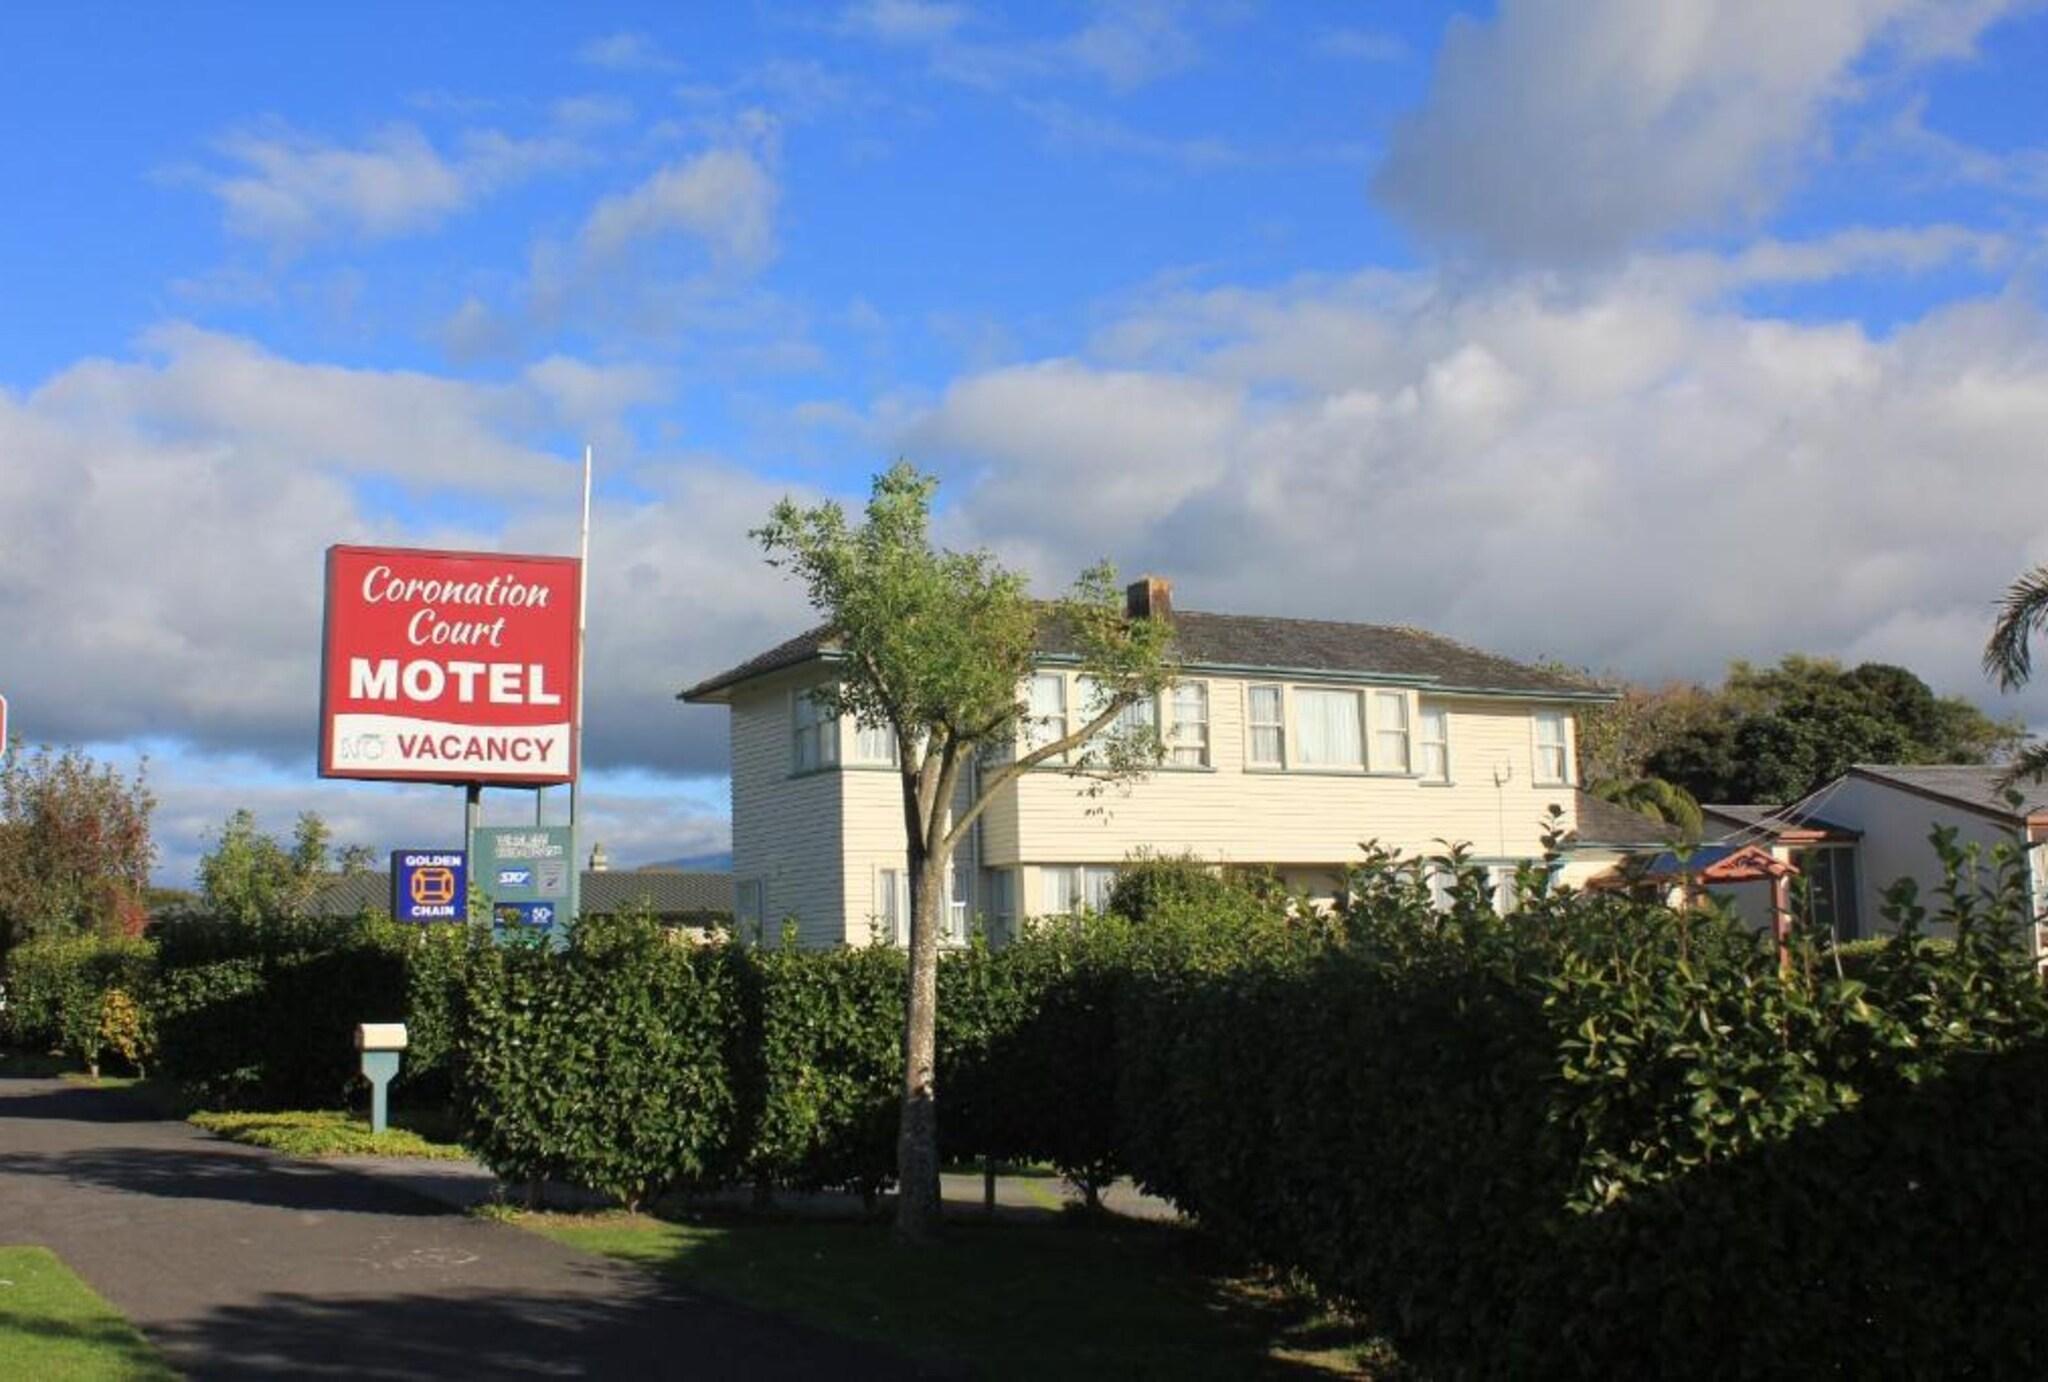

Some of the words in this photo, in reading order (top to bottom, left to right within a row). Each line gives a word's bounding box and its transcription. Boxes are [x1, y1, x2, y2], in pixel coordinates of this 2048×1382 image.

[362, 566, 549, 607] Coronation
[408, 609, 505, 647] Court
[350, 658, 560, 705] MOTEL
[341, 734, 384, 759] NO
[397, 734, 554, 761] VACANCY
[406, 856, 461, 866] GOLDEN
[411, 905, 455, 917] CHAIN
